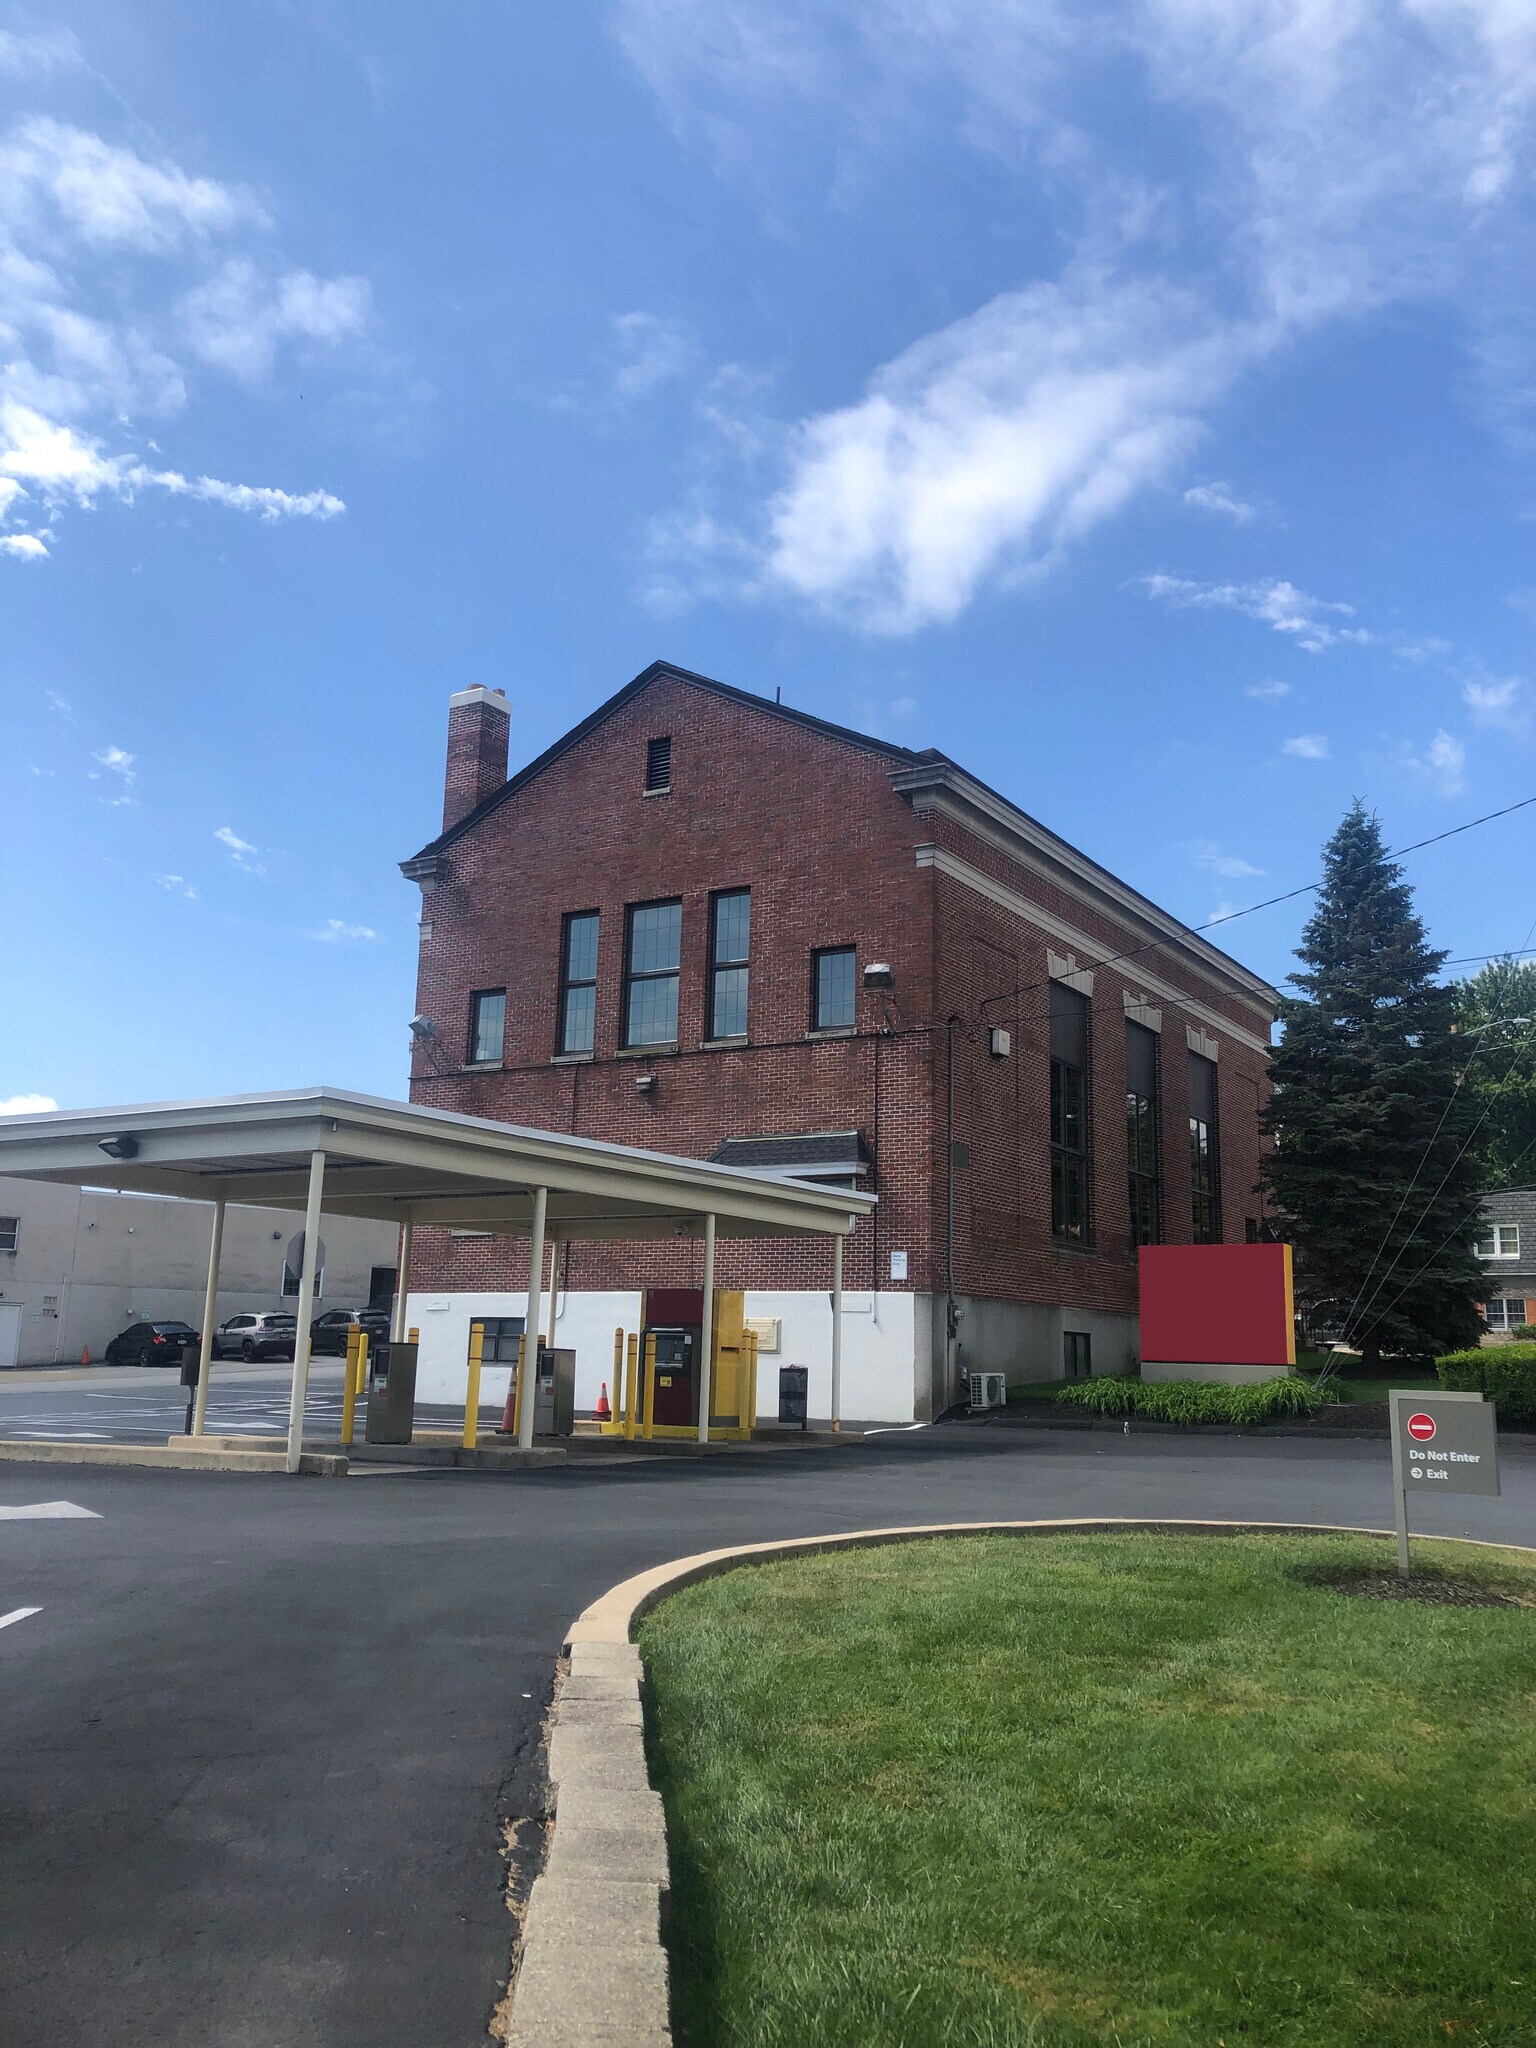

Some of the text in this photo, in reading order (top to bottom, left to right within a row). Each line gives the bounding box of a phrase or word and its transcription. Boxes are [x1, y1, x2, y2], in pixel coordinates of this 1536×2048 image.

[1409, 1449, 1480, 1463] Do Not Enter
[1426, 1468, 1448, 1480] Exit
